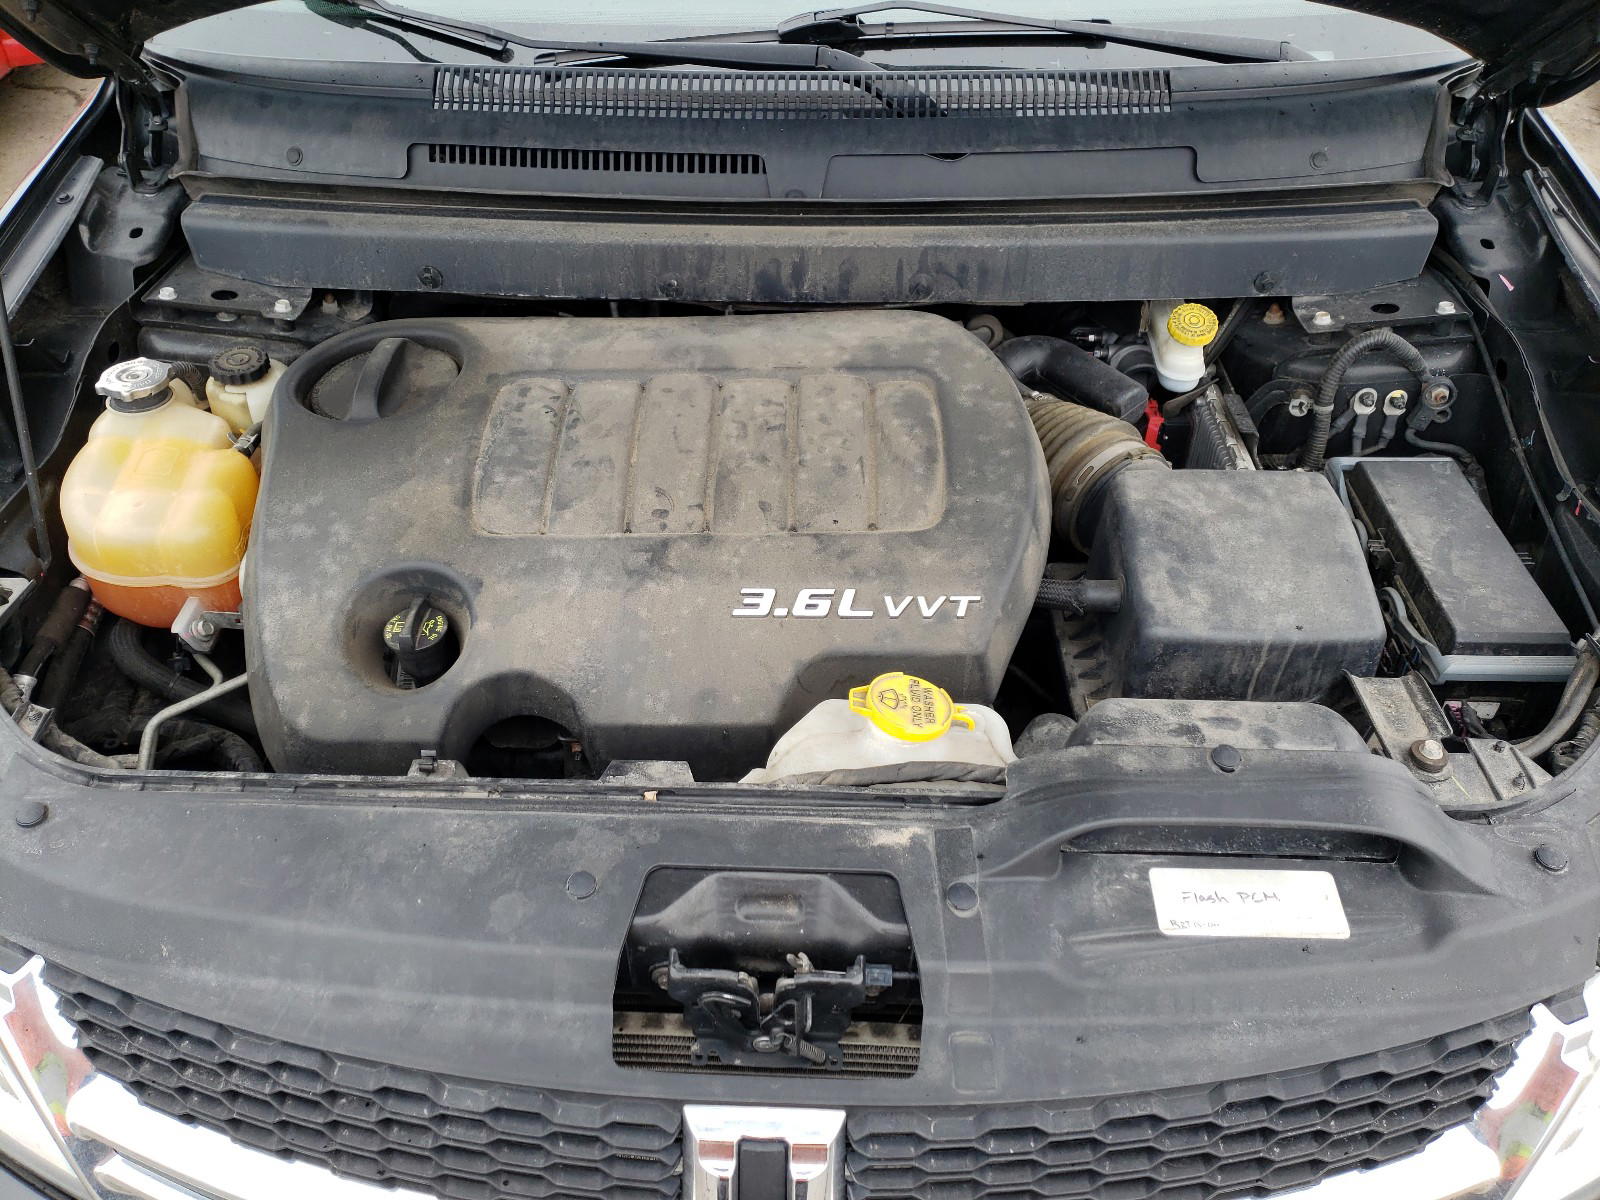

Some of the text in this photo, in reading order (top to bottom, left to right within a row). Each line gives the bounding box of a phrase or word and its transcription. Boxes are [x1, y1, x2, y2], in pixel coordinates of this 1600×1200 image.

[731, 587, 982, 619] 3.6L VVT
[908, 678, 923, 728] FLUID ONLY
[923, 687, 936, 724] WASHER
[1181, 890, 1229, 904] Flash
